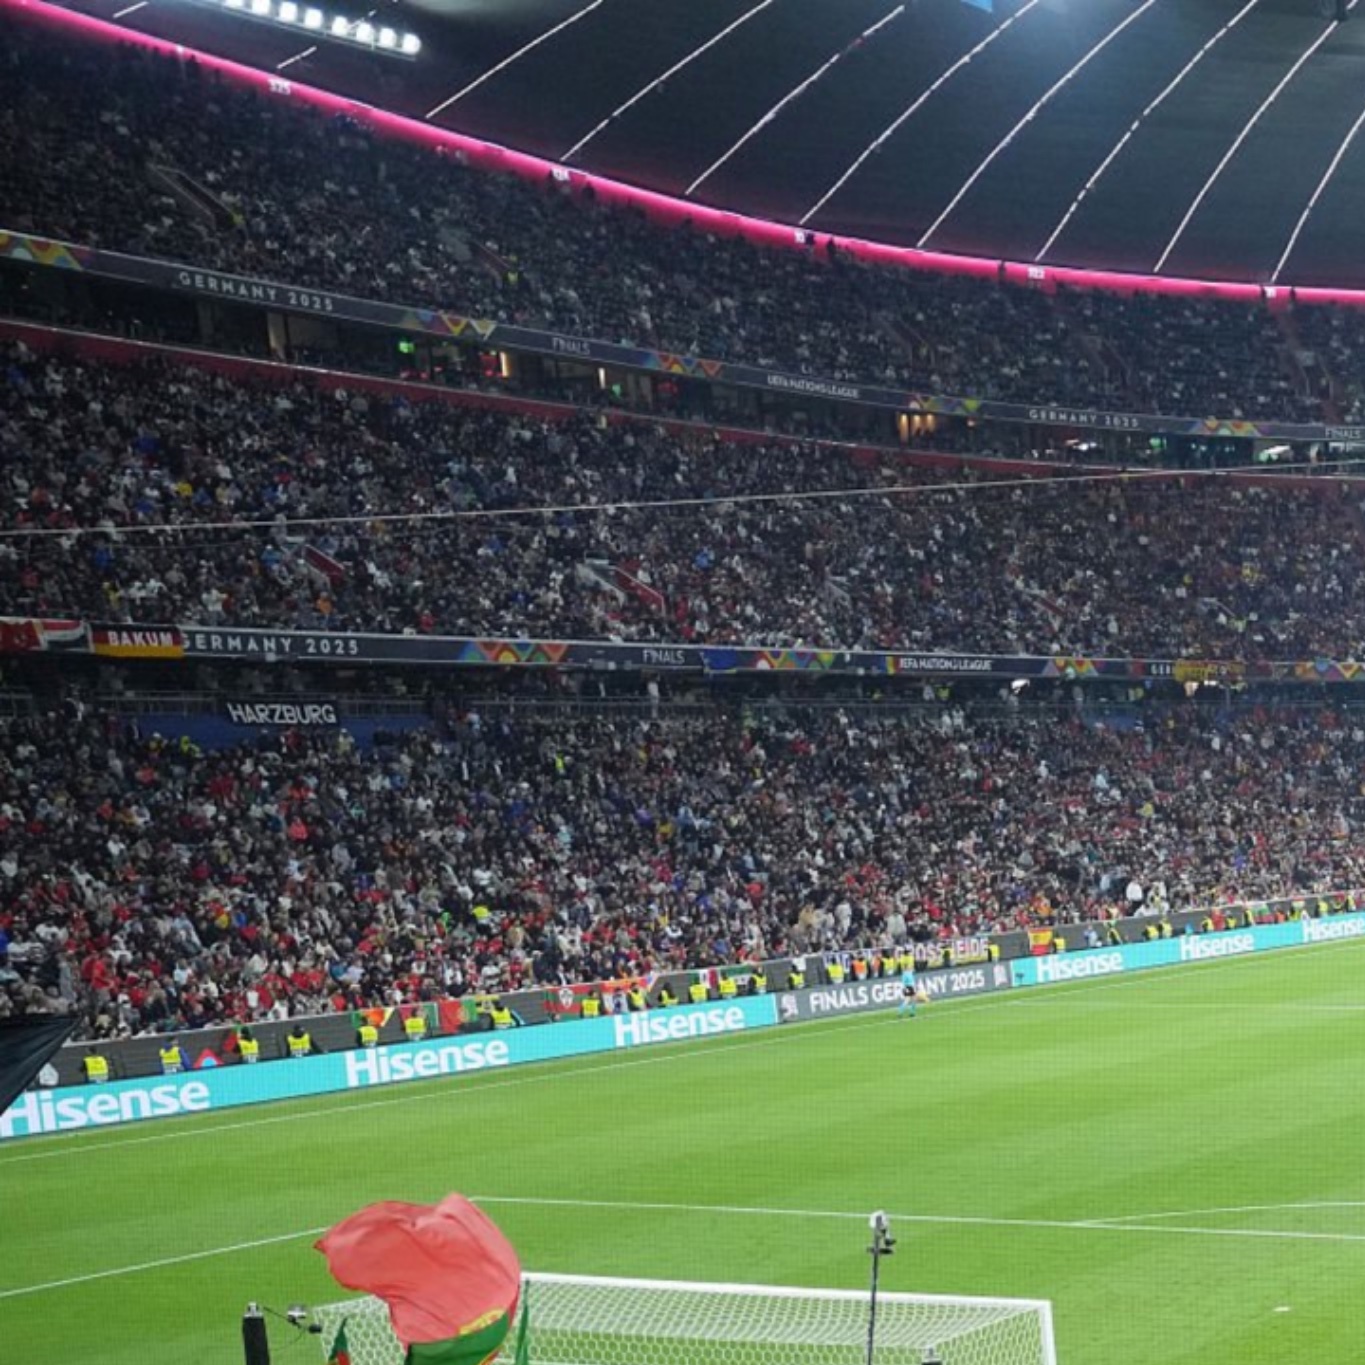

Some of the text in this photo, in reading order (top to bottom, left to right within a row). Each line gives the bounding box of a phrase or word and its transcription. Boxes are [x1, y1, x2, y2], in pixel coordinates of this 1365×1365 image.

[179, 272, 333, 311] GERMANY 2025
[1029, 410, 1097, 424] GERMANY
[107, 630, 173, 647] BAKUM
[181, 632, 359, 655] GERMANY 2025
[642, 648, 685, 665] FINALS
[959, 659, 992, 671] LEAGUE
[227, 702, 336, 724] HARZBURG
[1180, 932, 1254, 960] Hisense
[1037, 952, 1122, 983] Hisense
[809, 969, 984, 1012] FINALS GERANY 2025
[614, 1005, 745, 1047] Hisense
[345, 1039, 509, 1088] Hisense
[0, 1081, 210, 1136] Hisense
